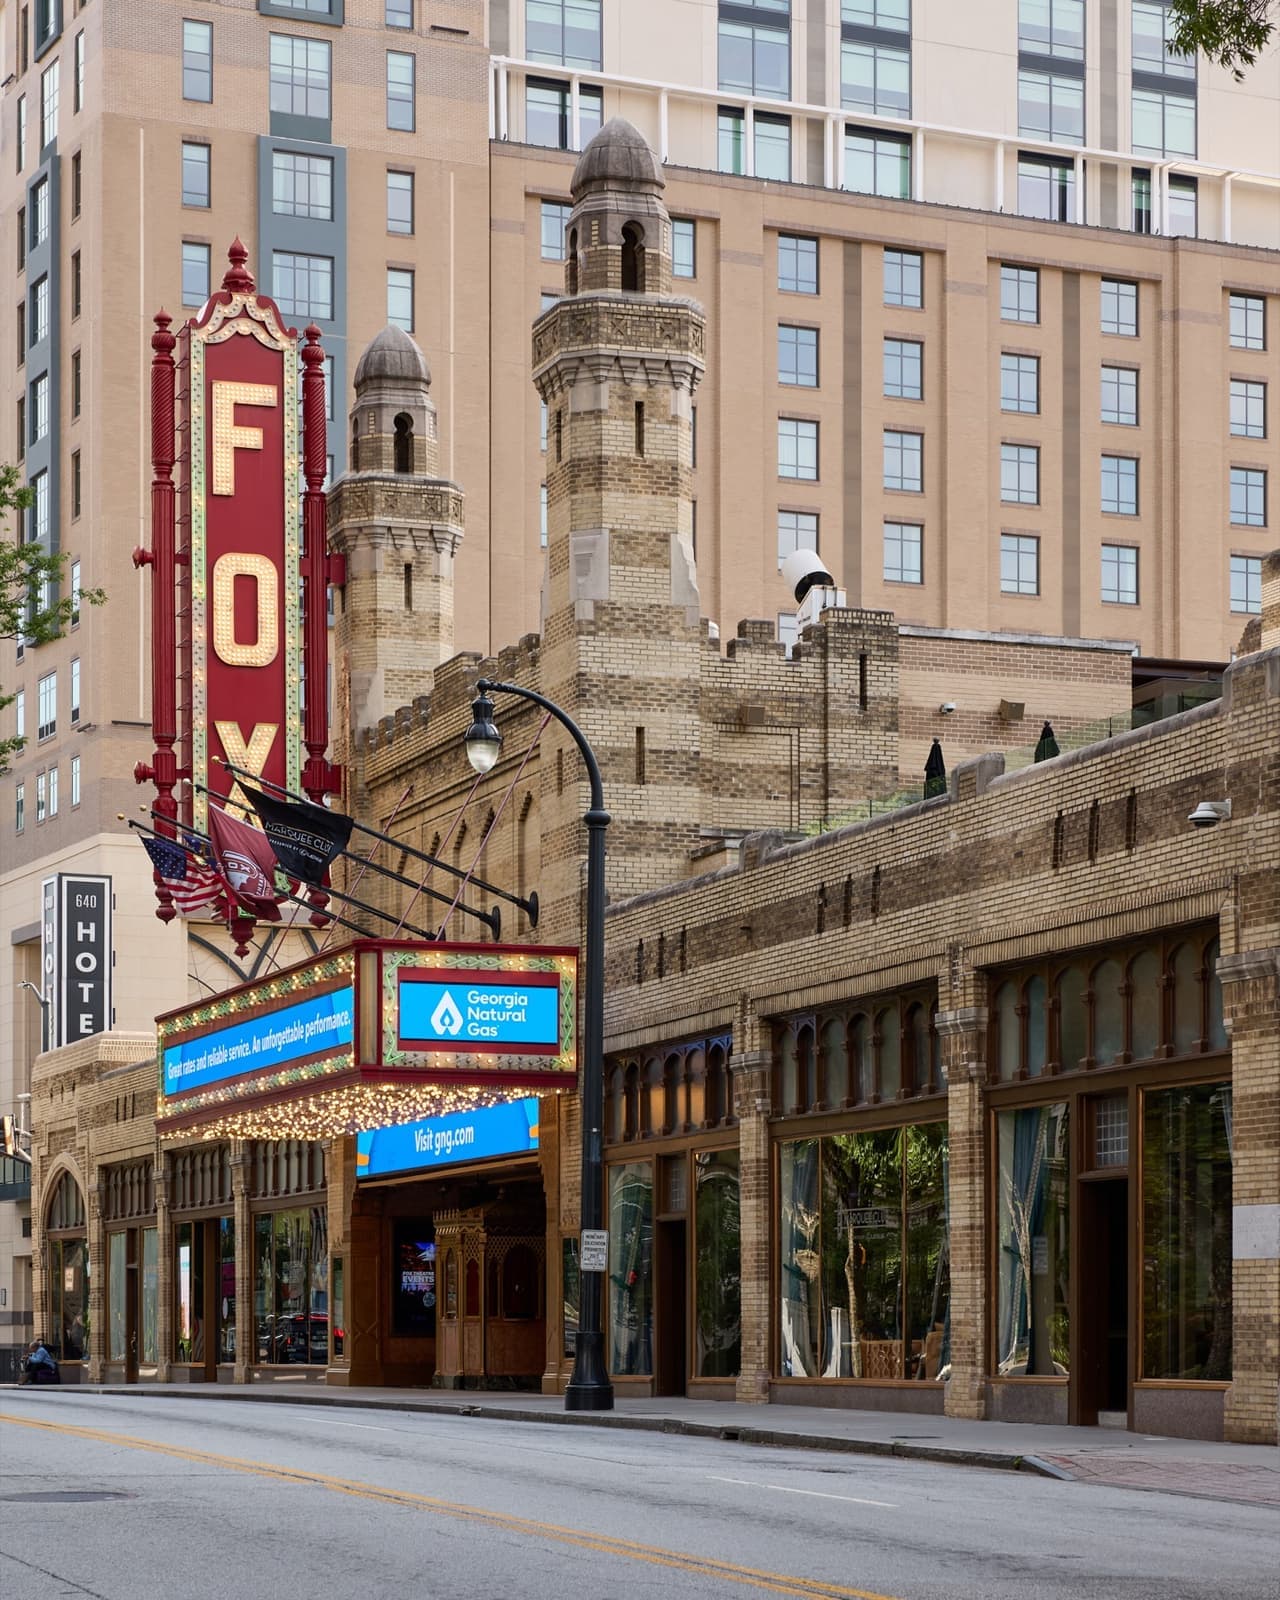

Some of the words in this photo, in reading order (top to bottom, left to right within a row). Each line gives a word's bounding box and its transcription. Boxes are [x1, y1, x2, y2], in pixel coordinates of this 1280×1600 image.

[211, 379, 279, 832] FOX
[265, 821, 313, 845] MARQUEE
[225, 861, 250, 873] OX
[75, 894, 97, 908] 640
[467, 990, 528, 1009] Georgia
[467, 1007, 526, 1022] Natural
[467, 1022, 498, 1037] Gas
[168, 1062, 182, 1080] Great
[182, 1058, 196, 1077] rates
[196, 1051, 207, 1071] and
[207, 1046, 228, 1067] reliable
[228, 1039, 250, 1061] service.
[251, 1035, 261, 1054] An
[261, 1025, 304, 1052] unforgettable
[304, 1009, 351, 1044] performance.
[415, 1130, 433, 1152] Visit
[434, 1125, 475, 1156] gng.com
[402, 1275, 435, 1283] EVENTS
